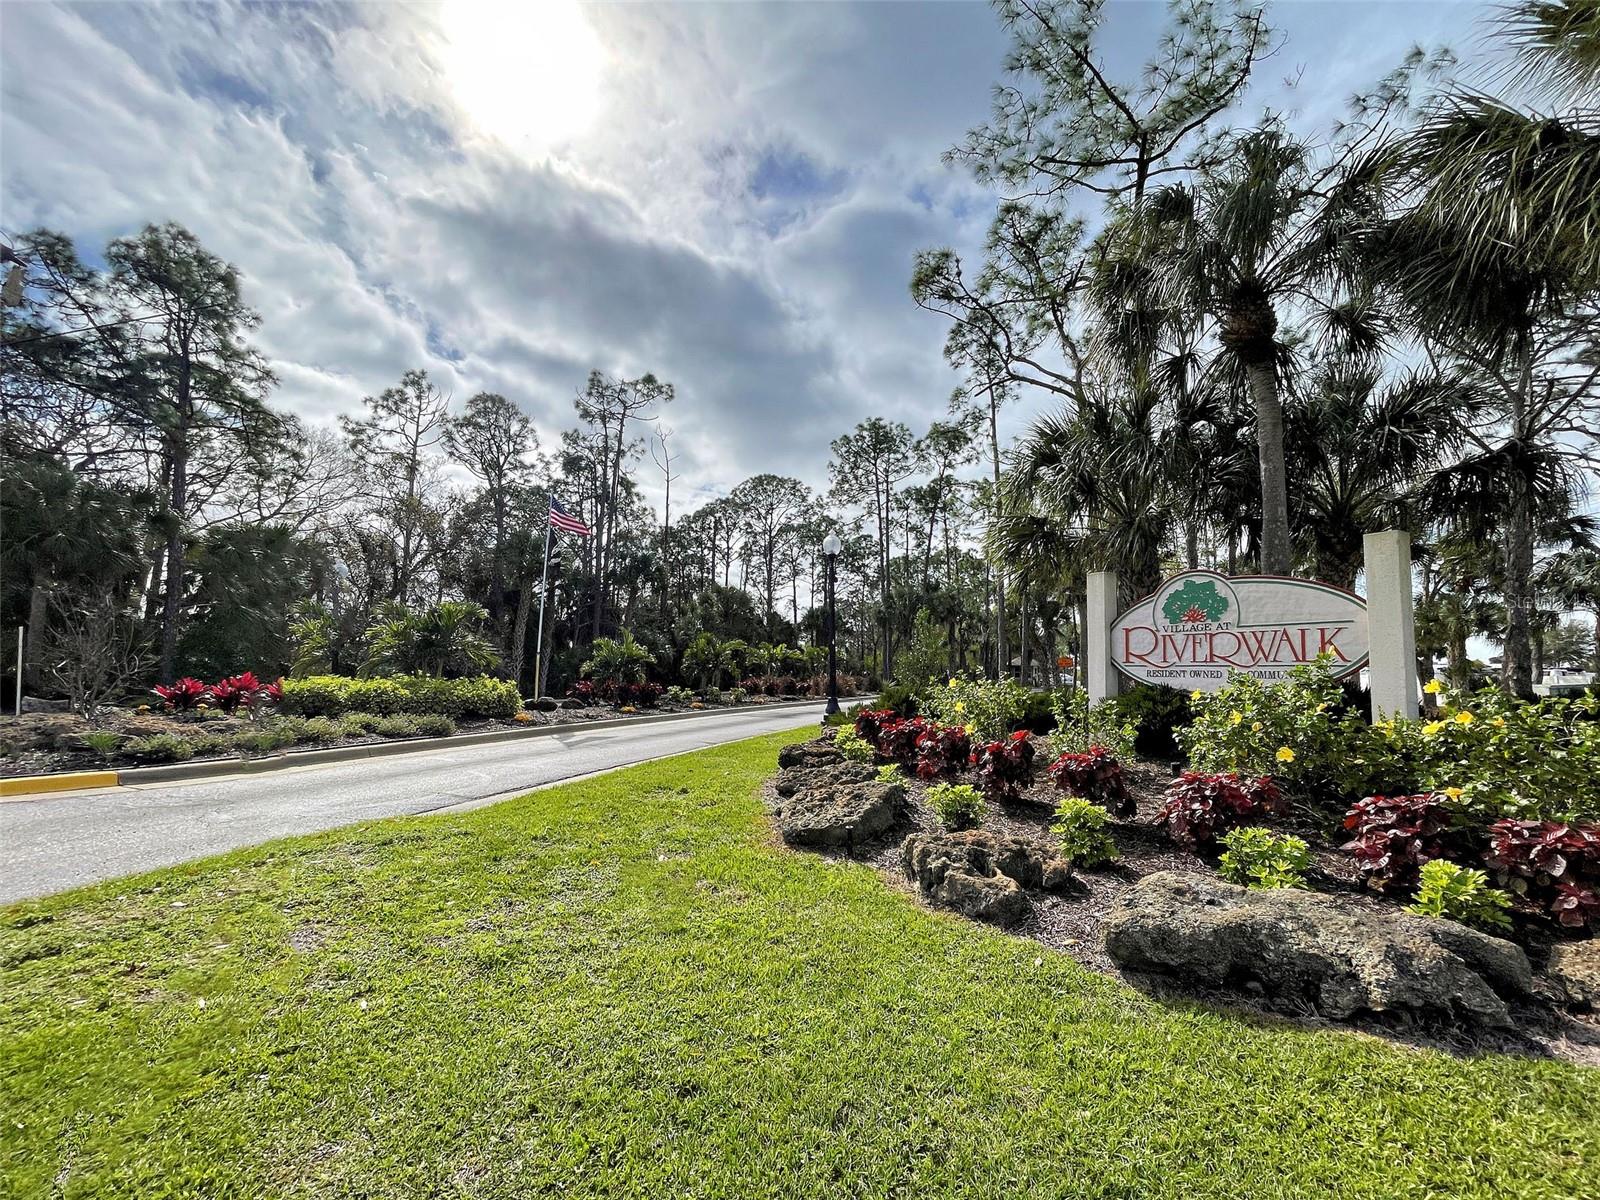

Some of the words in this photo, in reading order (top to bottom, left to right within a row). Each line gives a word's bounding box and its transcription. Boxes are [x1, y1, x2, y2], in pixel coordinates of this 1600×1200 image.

[1162, 623, 1212, 633] VILLAGE
[1215, 622, 1232, 631] AT
[1122, 627, 1352, 668] RIVERWALK
[1146, 669, 1188, 679] RESIDENT
[1189, 670, 1223, 679] OWNED
